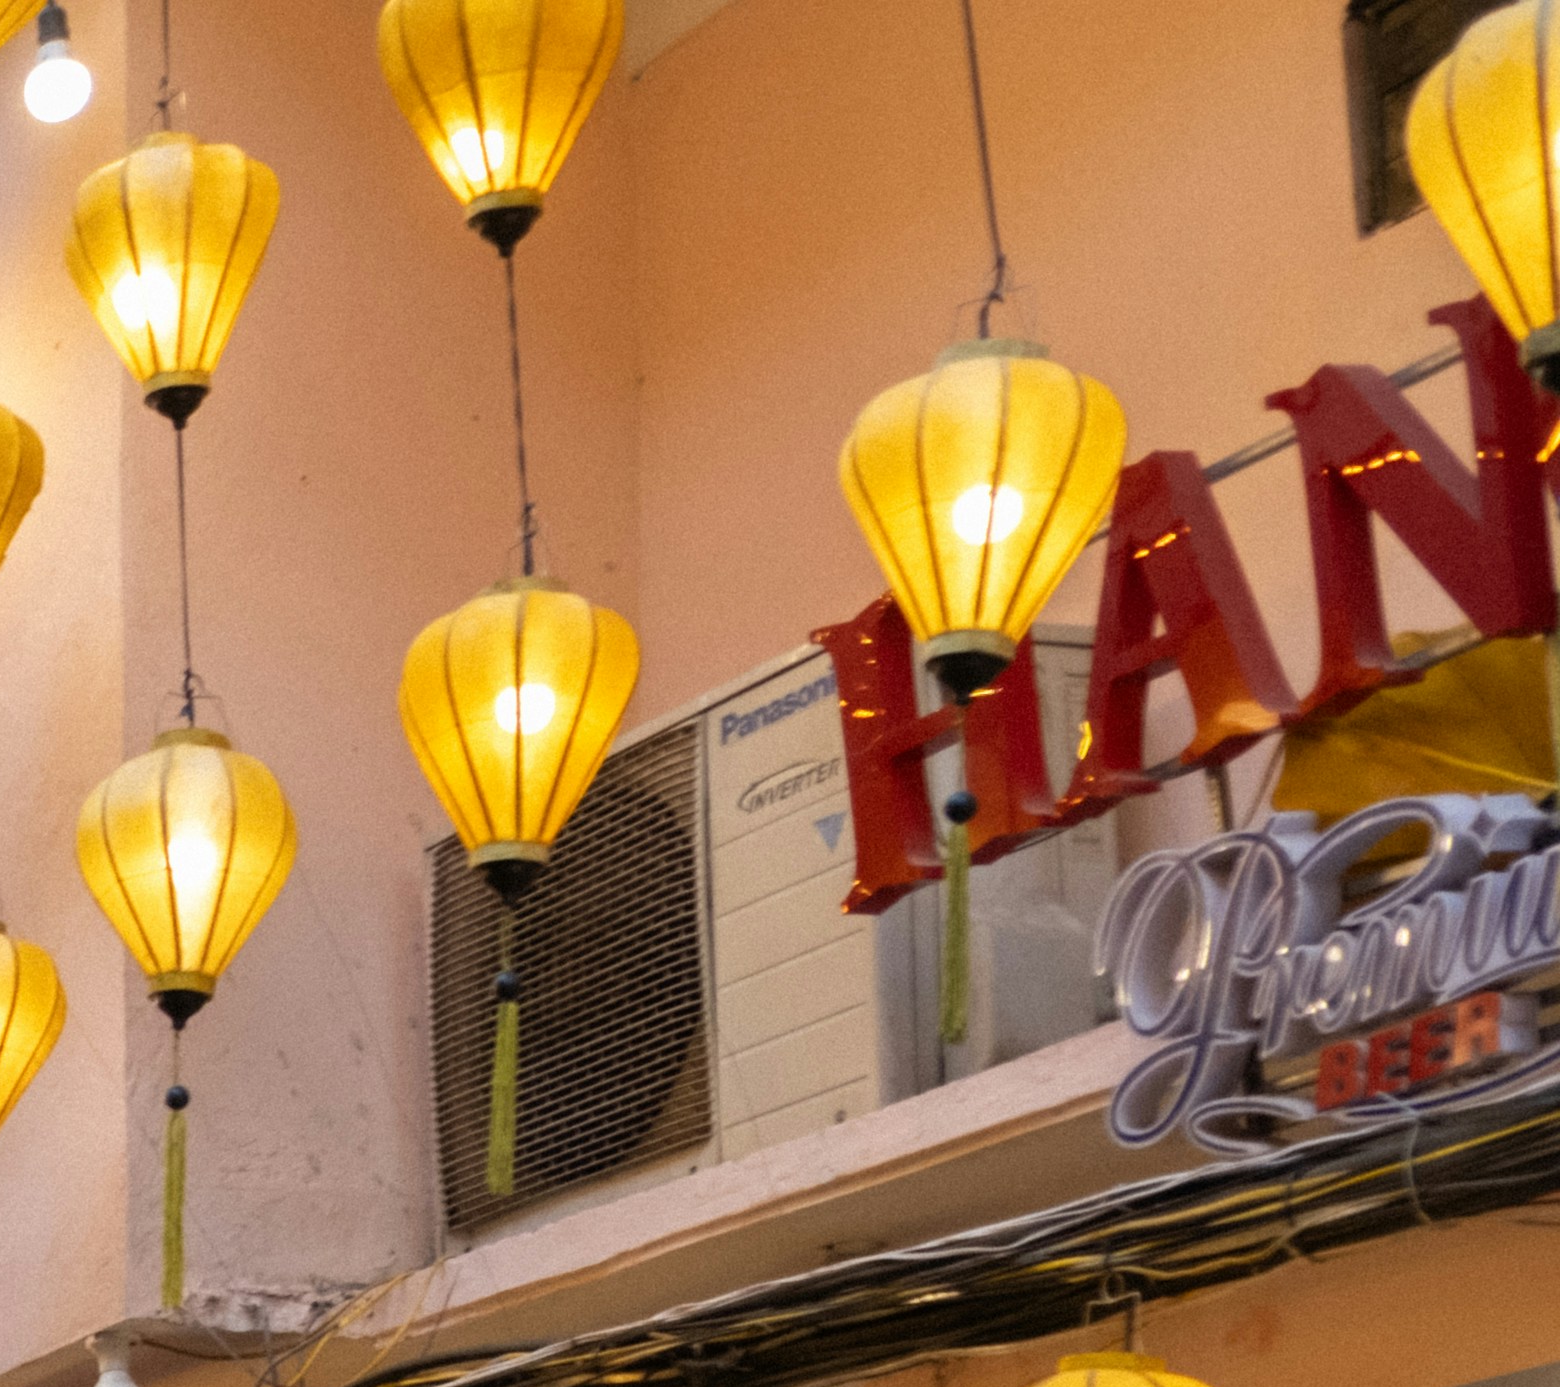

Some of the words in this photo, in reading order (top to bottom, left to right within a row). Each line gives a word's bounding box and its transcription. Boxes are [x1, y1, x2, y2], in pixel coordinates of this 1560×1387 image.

[811, 294, 1560, 915] HAN
[720, 667, 837, 746] Panasoni
[1315, 992, 1503, 1110] BEER
